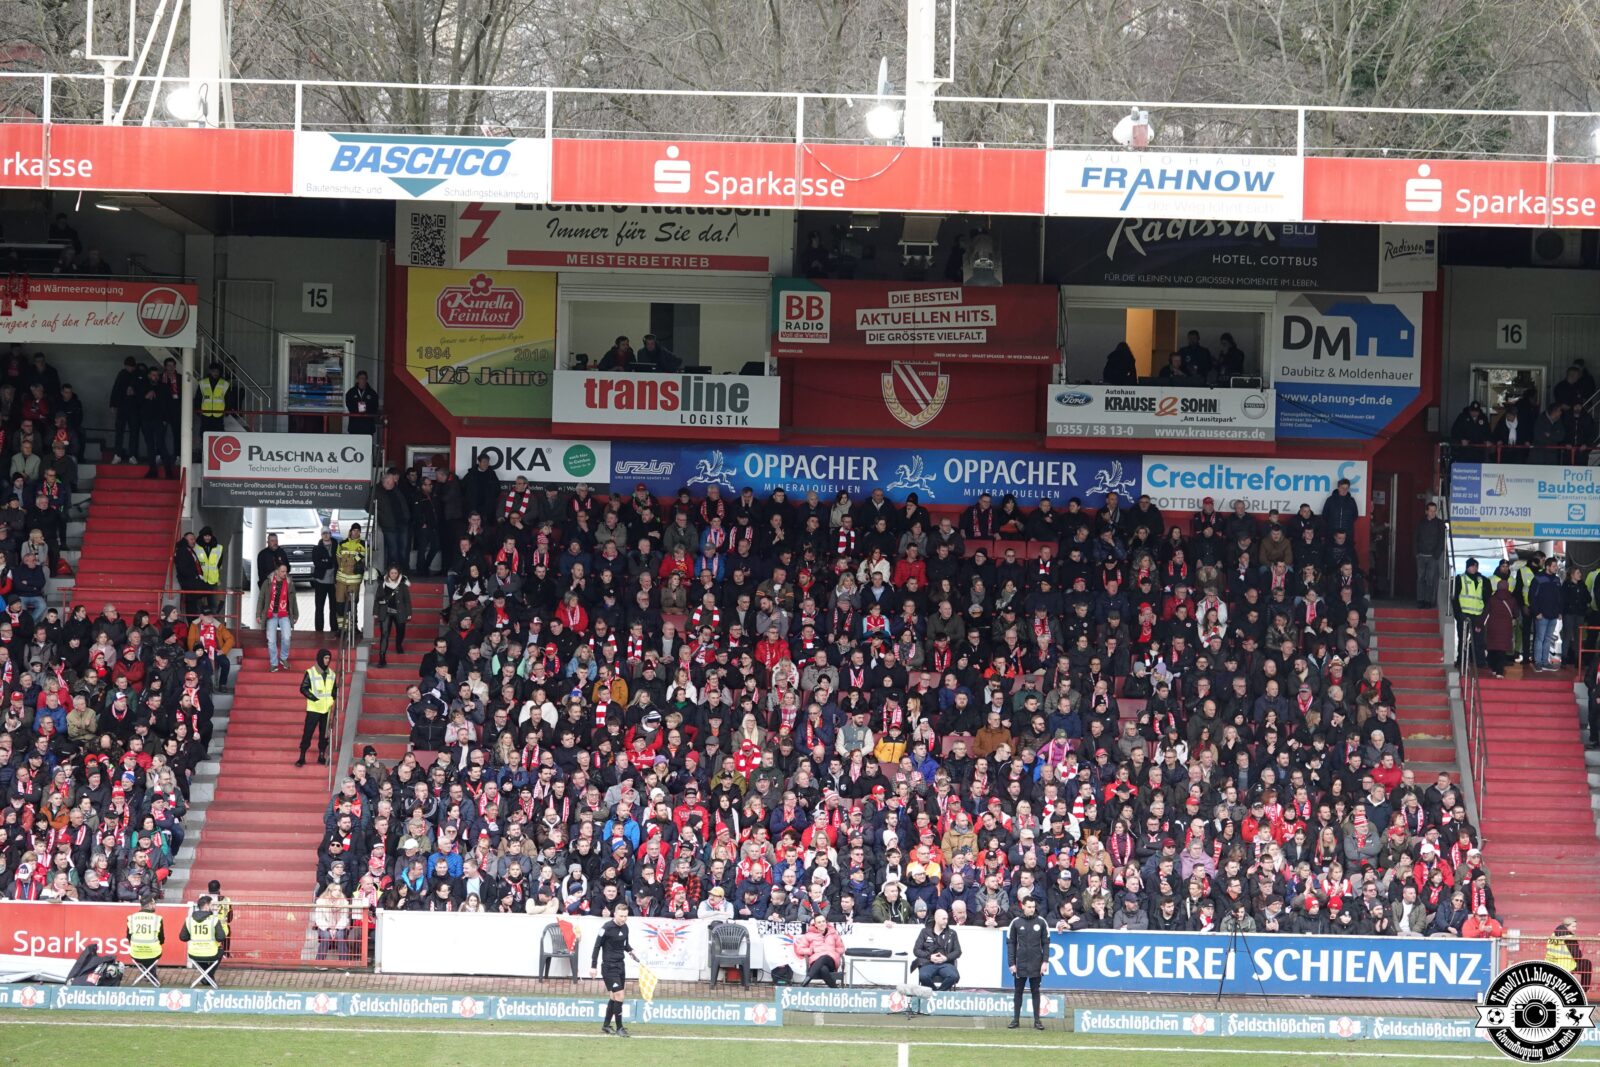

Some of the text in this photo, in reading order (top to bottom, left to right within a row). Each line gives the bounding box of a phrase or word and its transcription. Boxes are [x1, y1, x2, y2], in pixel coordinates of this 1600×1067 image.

[3, 151, 93, 177] rkasse
[330, 145, 511, 177] BASCHCO
[704, 171, 845, 200] Sparkasse
[1081, 167, 1275, 211] FRAHNOW
[1456, 189, 1596, 218] Sparkasse
[547, 218, 737, 247] Immer für Sie da!
[1282, 224, 1316, 236] BLU
[566, 254, 711, 268] MEISTERBETRIEB
[1212, 254, 1318, 267] HOTEL, COTTBUS
[1104, 273, 1120, 281] FÜR
[1122, 274, 1136, 282] DIE
[1137, 274, 1172, 283] KLEINEN
[1173, 275, 1193, 284] UND
[1195, 276, 1235, 285] GROSSEN
[1236, 277, 1278, 286] MOMENTE
[1280, 278, 1290, 287] IM
[43, 285, 124, 296] Wärmeerzeugung
[307, 288, 328, 308] 15
[891, 291, 960, 305] DIE BESTEN
[444, 292, 514, 310] Kunella
[785, 295, 825, 321] BB
[41, 313, 60, 332] auf
[62, 315, 79, 328] den
[85, 312, 125, 328] Punkt!
[449, 309, 511, 323] Feinkost
[785, 321, 824, 331] RADIO
[860, 309, 994, 326] AKTUELLEN HITS.
[868, 331, 984, 342] DIE GRÖSSTE VIELFALT.
[1282, 315, 1351, 361] DM
[1501, 324, 1522, 344] 16
[416, 346, 452, 360] 1894
[425, 365, 548, 387] 125 Jahre
[1281, 366, 1414, 381] Daubitz & Moldenhauer
[584, 375, 750, 414] transline
[1061, 393, 1087, 405] Ford
[1105, 388, 1136, 396] Autohaus
[1104, 396, 1218, 417] KRAUSE & SOHN
[680, 414, 749, 426] LOGISTIK
[1055, 424, 1083, 435] 0355
[1092, 425, 1106, 436] 58
[1110, 425, 1134, 436] 13-0
[1154, 426, 1266, 440] www.krausecars.de
[327, 451, 338, 463] &
[744, 452, 879, 481] OPPACHER
[248, 464, 339, 474] Technischer Großhandel
[943, 457, 1079, 486] OPPACHER
[1146, 463, 1331, 492] Creditreform
[1563, 469, 1593, 481] Profi
[277, 482, 304, 490] Plaschna
[258, 498, 313, 506] www.plaschna.de
[1451, 505, 1531, 517] Mobil: 0171 7343191
[135, 923, 152, 935] 261
[193, 924, 209, 935] 115
[757, 921, 802, 936] SCHEISS
[13, 930, 131, 957] Sparkass
[1044, 943, 1483, 986] RUCKEREI SCHIEMENZ
[57, 986, 155, 1009] Feldschlößchen
[204, 989, 301, 1013] Feldschlößchen
[350, 993, 448, 1015] Feldschlößchen
[782, 988, 877, 1010] Feldschlößchen
[926, 991, 1015, 1013] Feldschlößche
[496, 997, 594, 1019] Feldschlößchen
[642, 1001, 740, 1023] Feldschlößchen
[1081, 1010, 1179, 1033] Feldschlößchen
[1228, 1013, 1326, 1036] Feldschlößchen
[1374, 1018, 1471, 1039] Feldschlößchen
